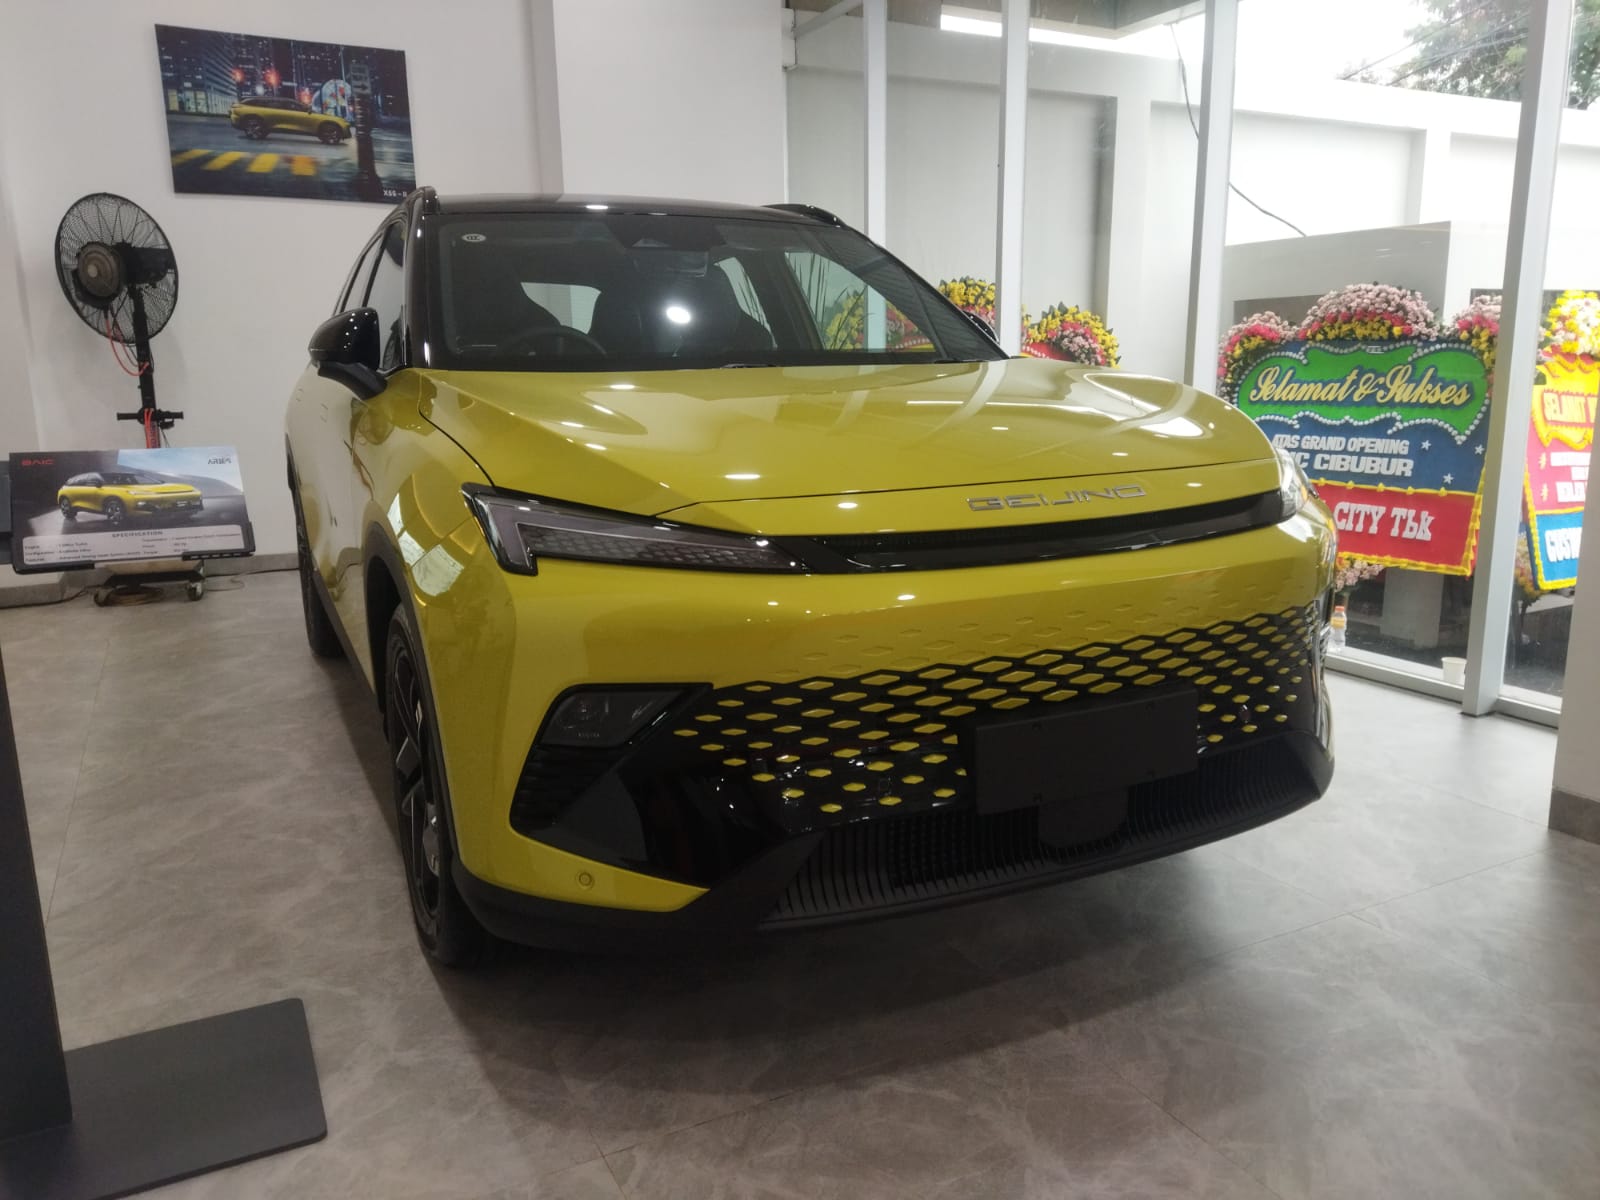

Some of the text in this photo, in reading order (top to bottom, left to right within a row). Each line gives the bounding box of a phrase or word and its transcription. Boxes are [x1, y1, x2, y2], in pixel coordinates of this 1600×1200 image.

[1250, 364, 1472, 406] Selamat & Sukses
[1301, 435, 1346, 452] GRAND
[1346, 437, 1410, 455] OPENING
[1313, 453, 1414, 477] CIBUBUR
[1333, 501, 1386, 535] CITY
